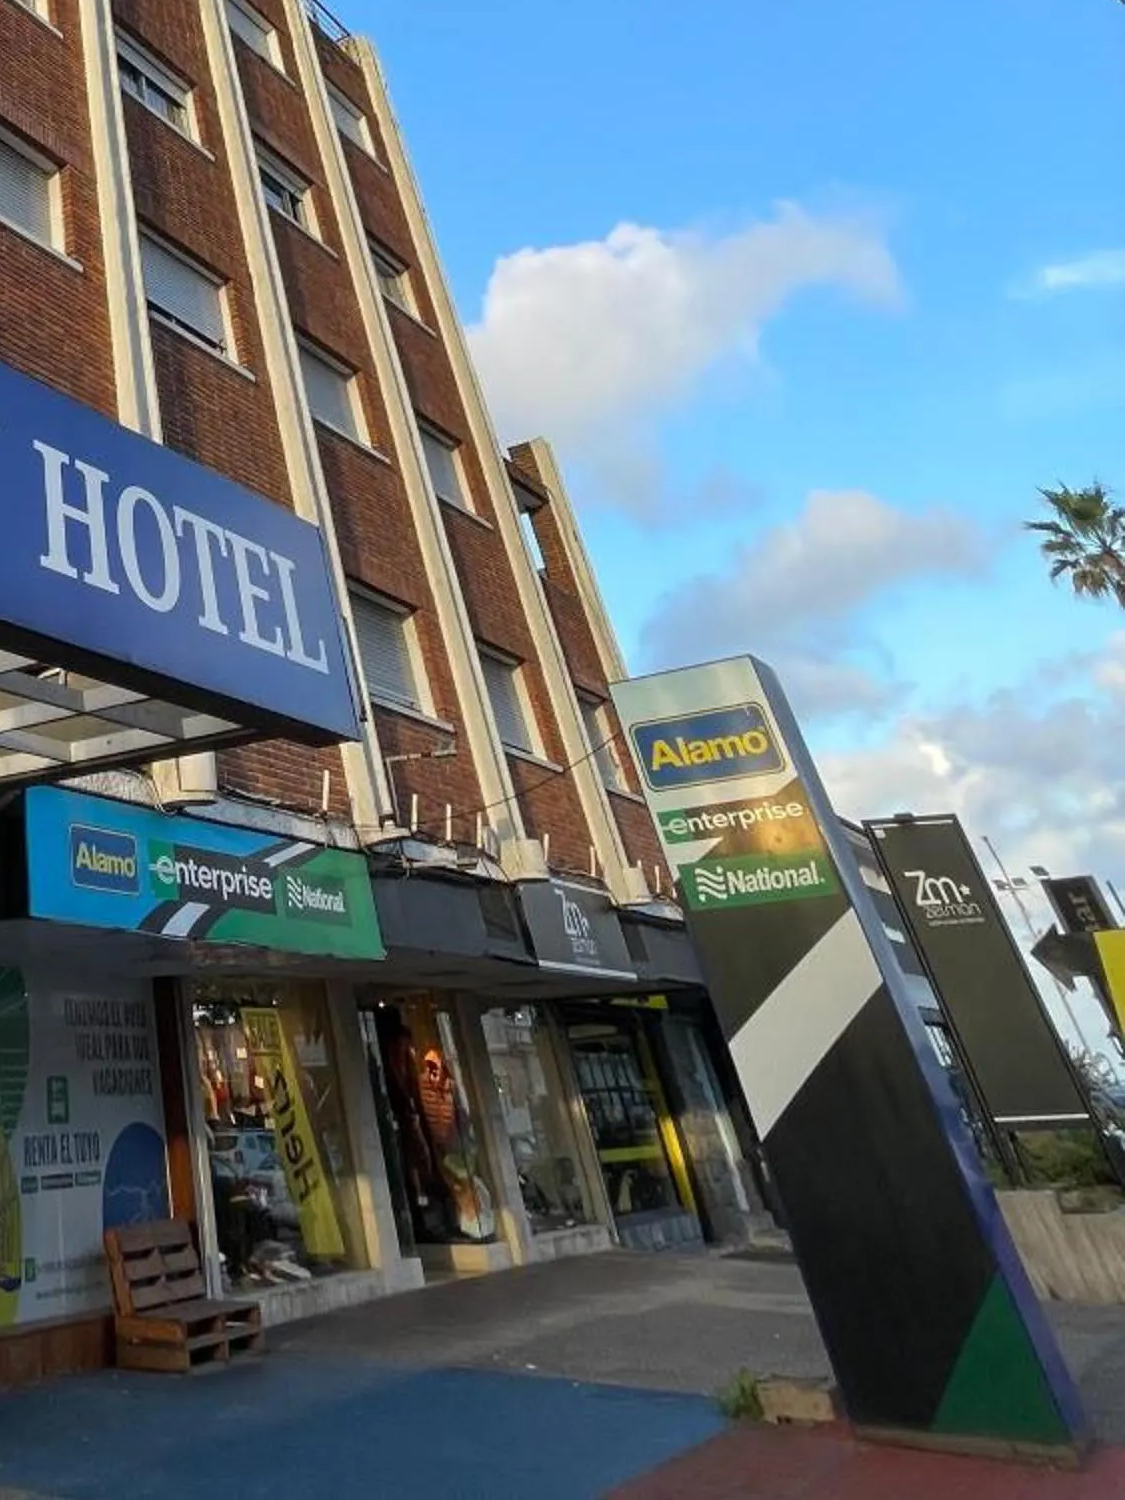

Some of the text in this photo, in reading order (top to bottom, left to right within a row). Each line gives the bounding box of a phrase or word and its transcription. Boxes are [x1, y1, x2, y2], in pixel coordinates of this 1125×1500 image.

[32, 438, 329, 674] HOTEL
[651, 729, 769, 772] Alamo
[661, 801, 804, 835] enterprise
[76, 842, 136, 878] Alamo
[151, 854, 274, 900] enterprise
